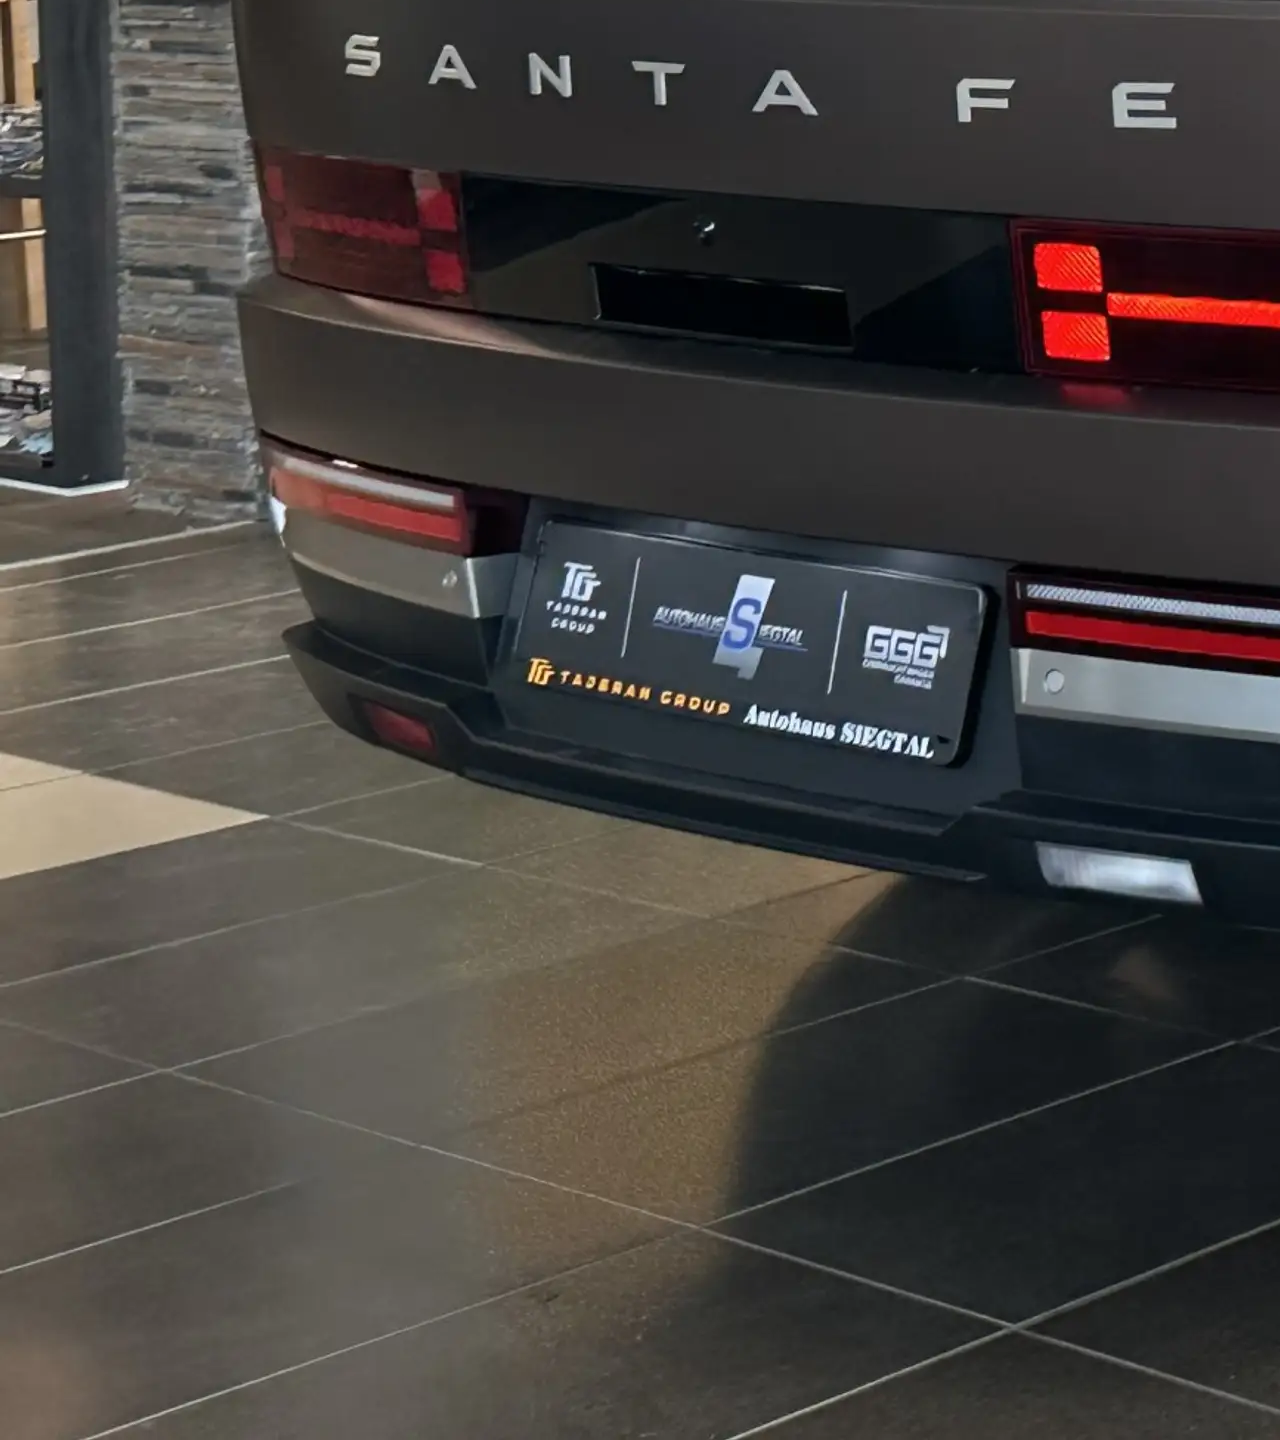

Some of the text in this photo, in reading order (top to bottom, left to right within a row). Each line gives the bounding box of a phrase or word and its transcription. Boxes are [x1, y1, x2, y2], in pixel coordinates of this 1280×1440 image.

[344, 33, 1178, 129] SANTA FE
[742, 703, 935, 760] Autohaus SIEGTAL
